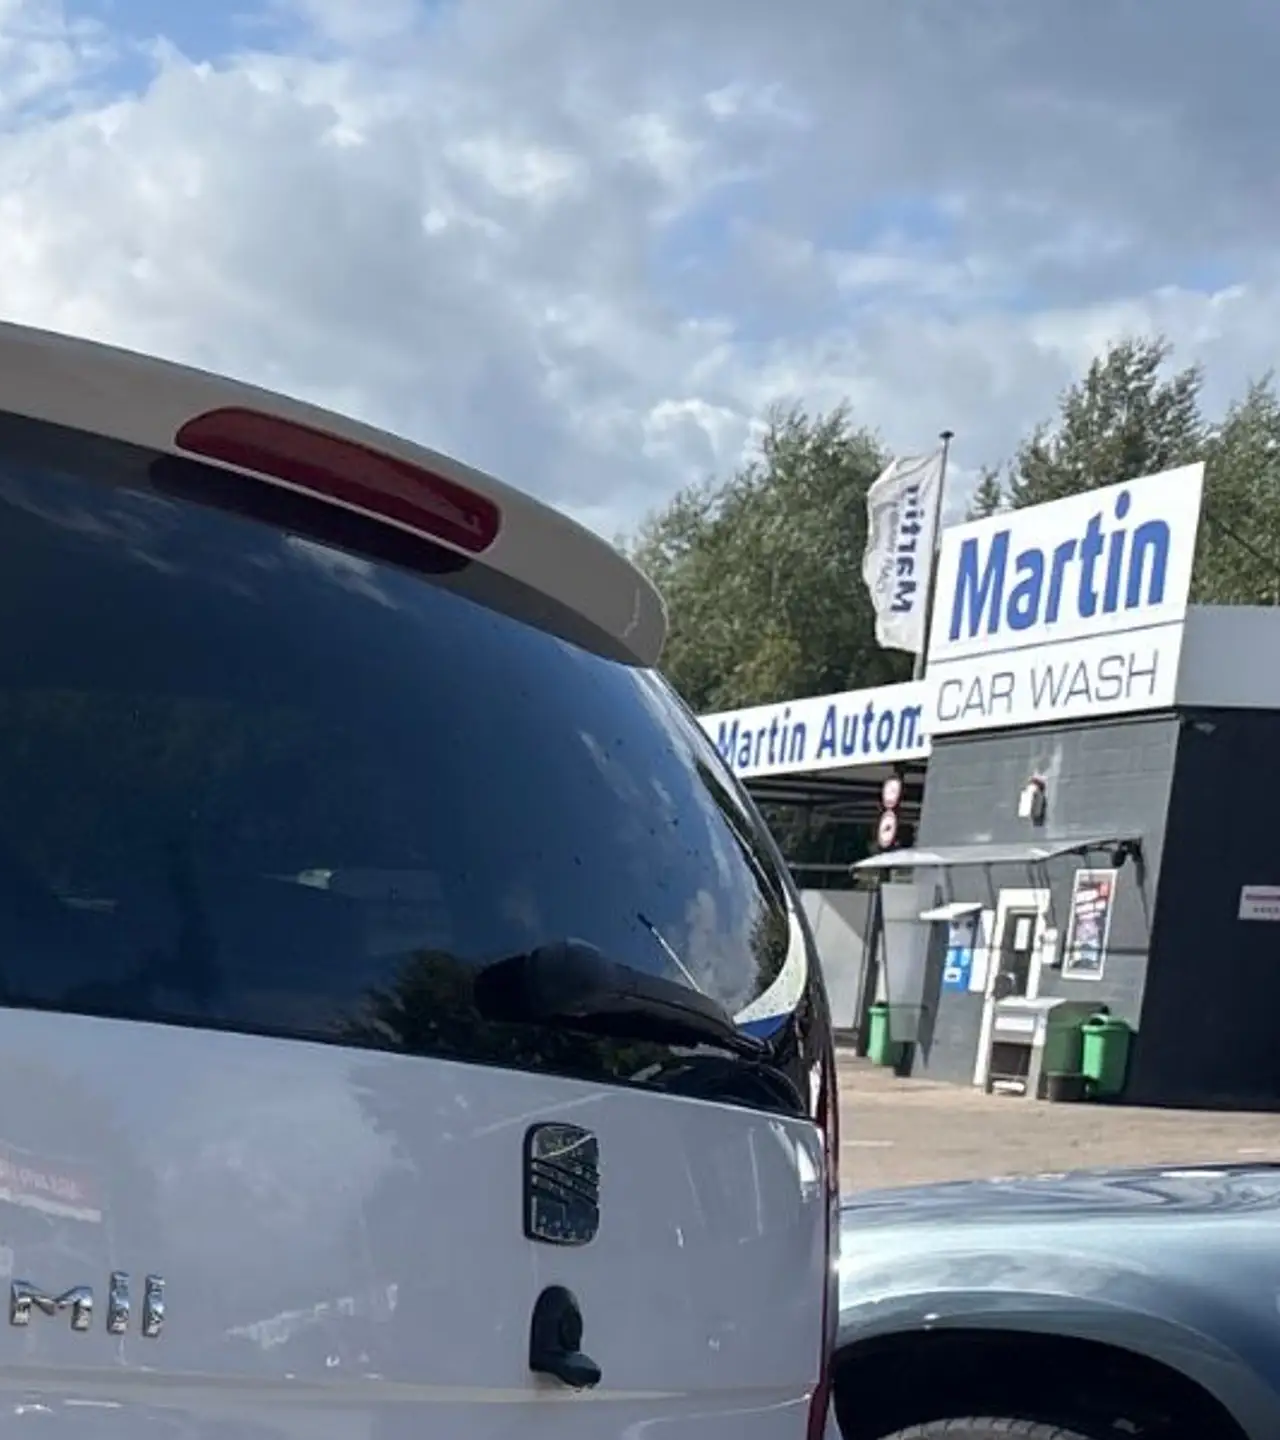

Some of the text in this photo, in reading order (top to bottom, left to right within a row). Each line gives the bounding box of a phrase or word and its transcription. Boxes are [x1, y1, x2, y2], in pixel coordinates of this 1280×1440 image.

[948, 489, 1171, 642] Martin
[937, 648, 1159, 721] CAR WASH
[717, 706, 807, 768] Martin
